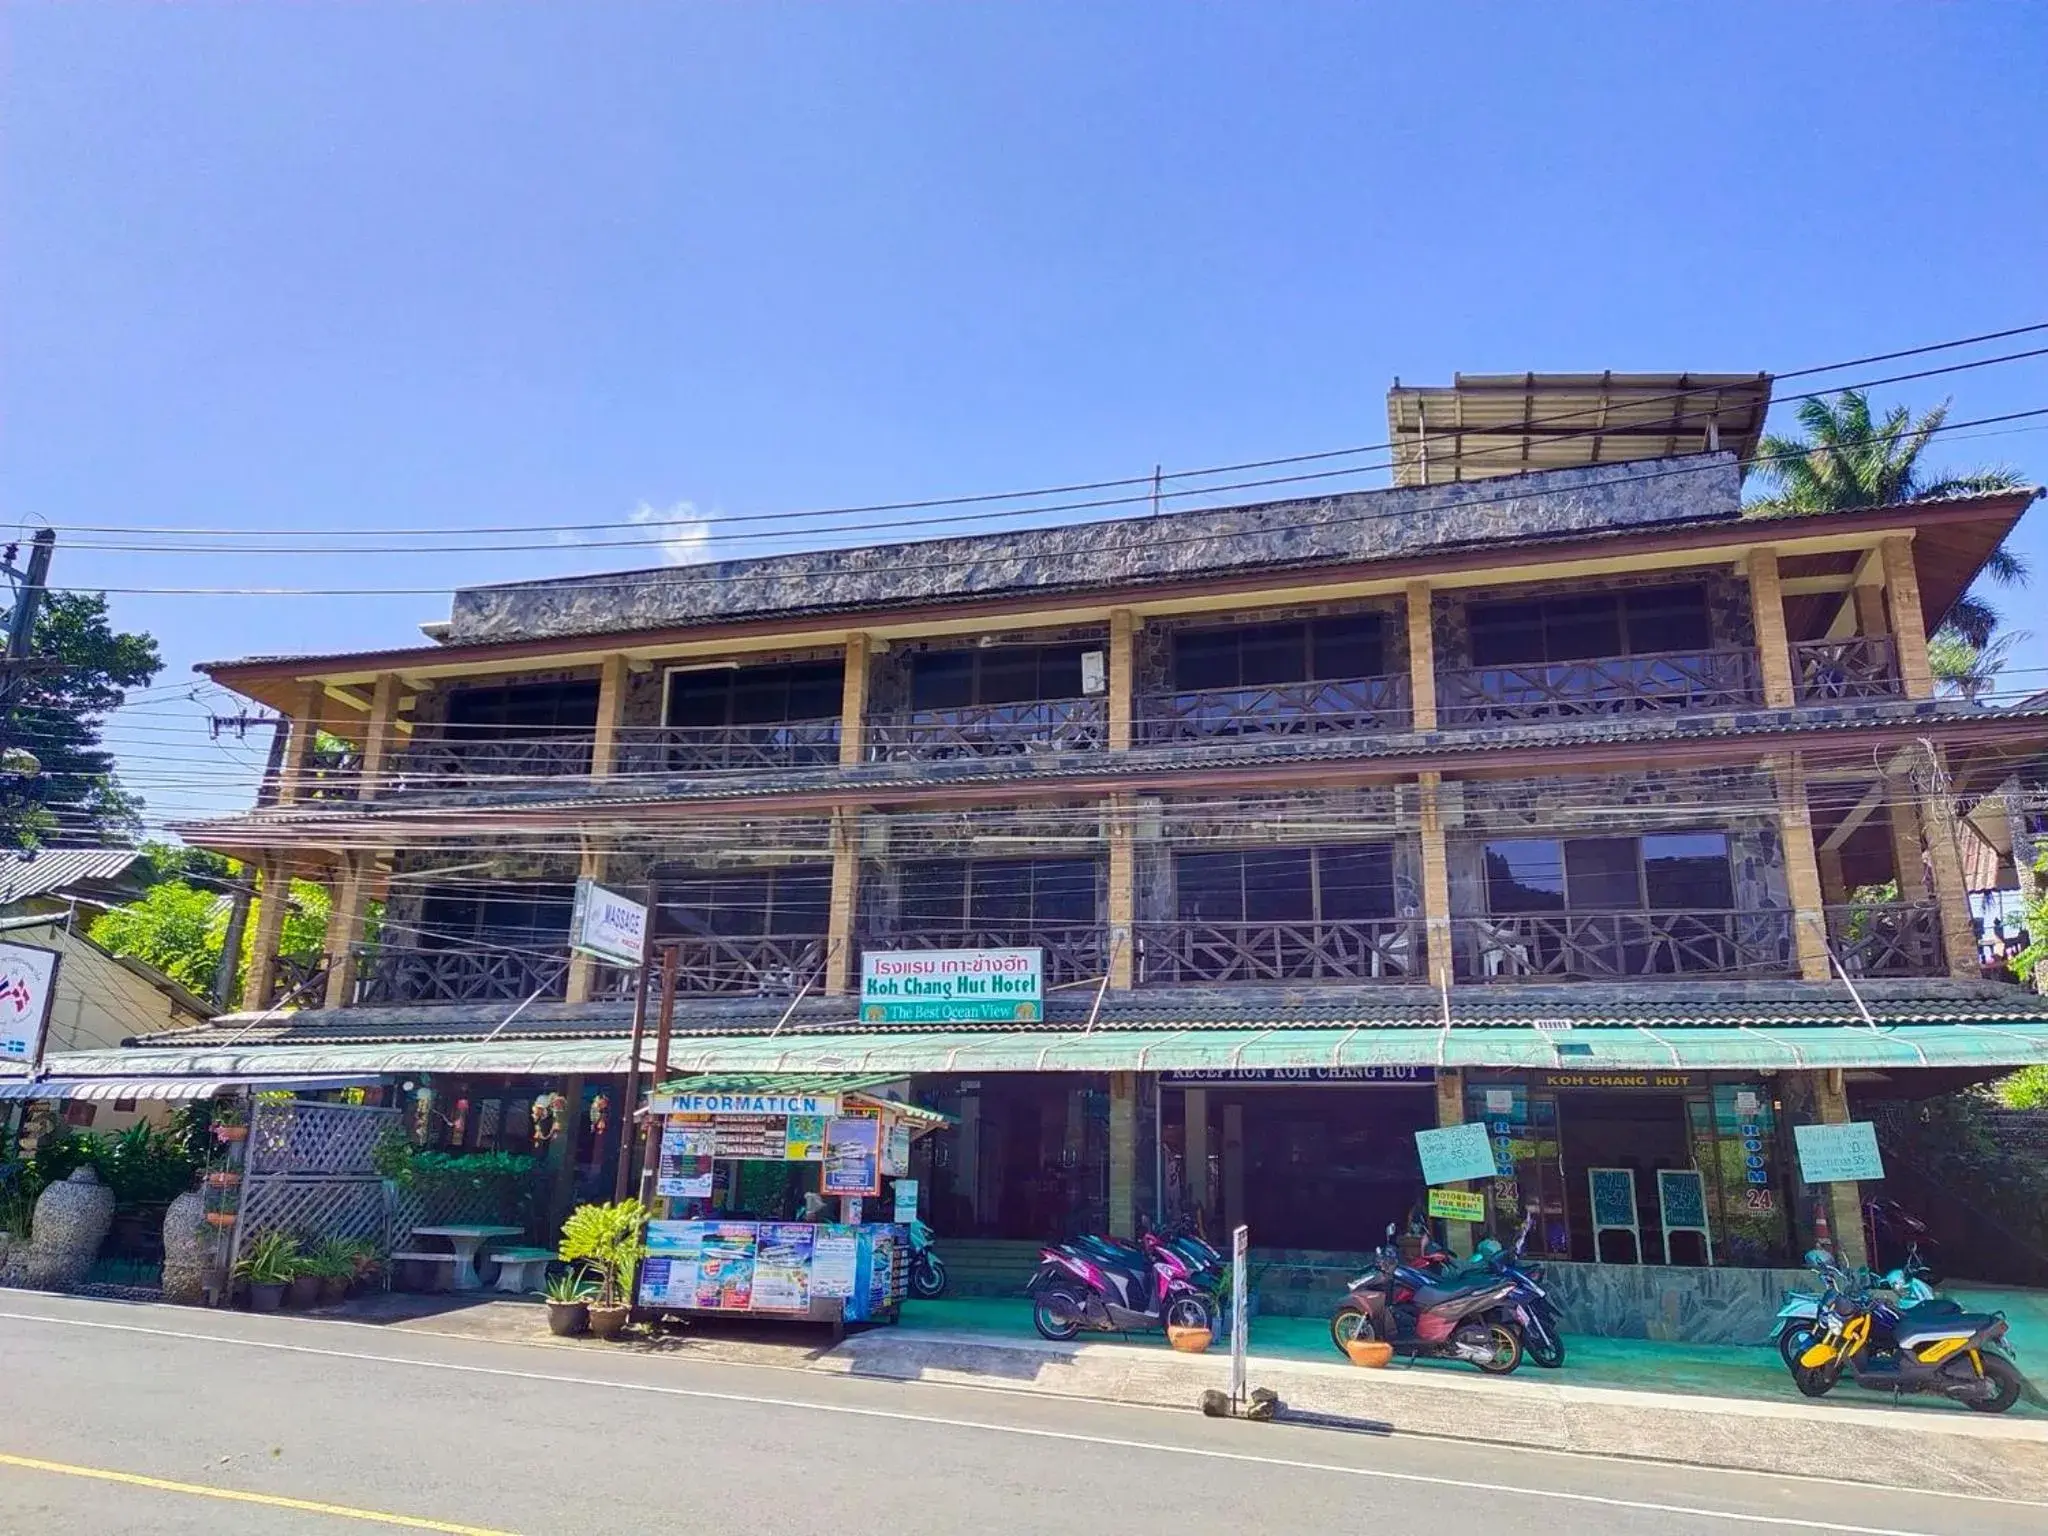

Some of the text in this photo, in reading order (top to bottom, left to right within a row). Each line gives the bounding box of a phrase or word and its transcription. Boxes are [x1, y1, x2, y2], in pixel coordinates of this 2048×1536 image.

[604, 905, 640, 934] MASSAGE
[875, 959, 935, 975] โรงแรม
[867, 974, 1035, 999] Koh Chang Hut Hotel
[891, 1004, 1010, 1019] The Best Ocean View
[1274, 1067, 1310, 1078] KOH
[1316, 1066, 1376, 1078] CHANG
[1383, 1066, 1418, 1078] HUT
[1547, 1075, 1690, 1085] KOH CHANG HUT
[1495, 1182, 1518, 1200] 24
[1747, 1189, 1772, 1208] 24
